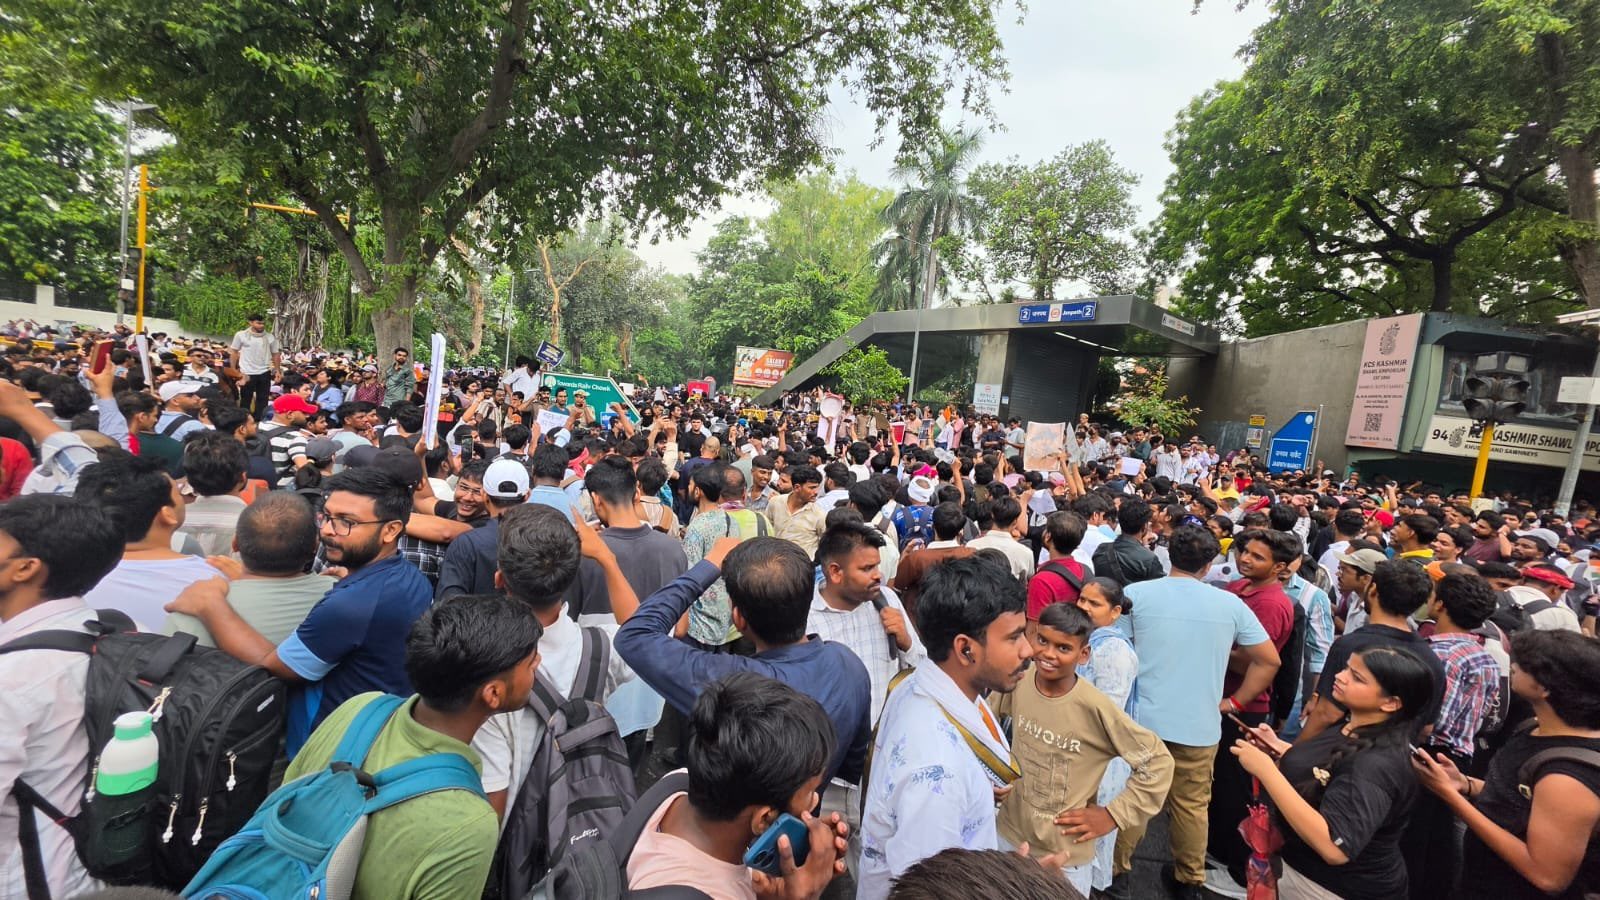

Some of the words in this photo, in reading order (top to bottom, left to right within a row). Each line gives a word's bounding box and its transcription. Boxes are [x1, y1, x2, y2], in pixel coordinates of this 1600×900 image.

[1022, 311, 1028, 319] 2
[1084, 308, 1091, 316] 2
[1376, 359, 1407, 367] KASHMIR
[556, 380, 577, 388] Towards
[591, 384, 611, 392] Chowk
[1431, 428, 1448, 441] 94
[1017, 714, 1082, 753] FAVOUR
